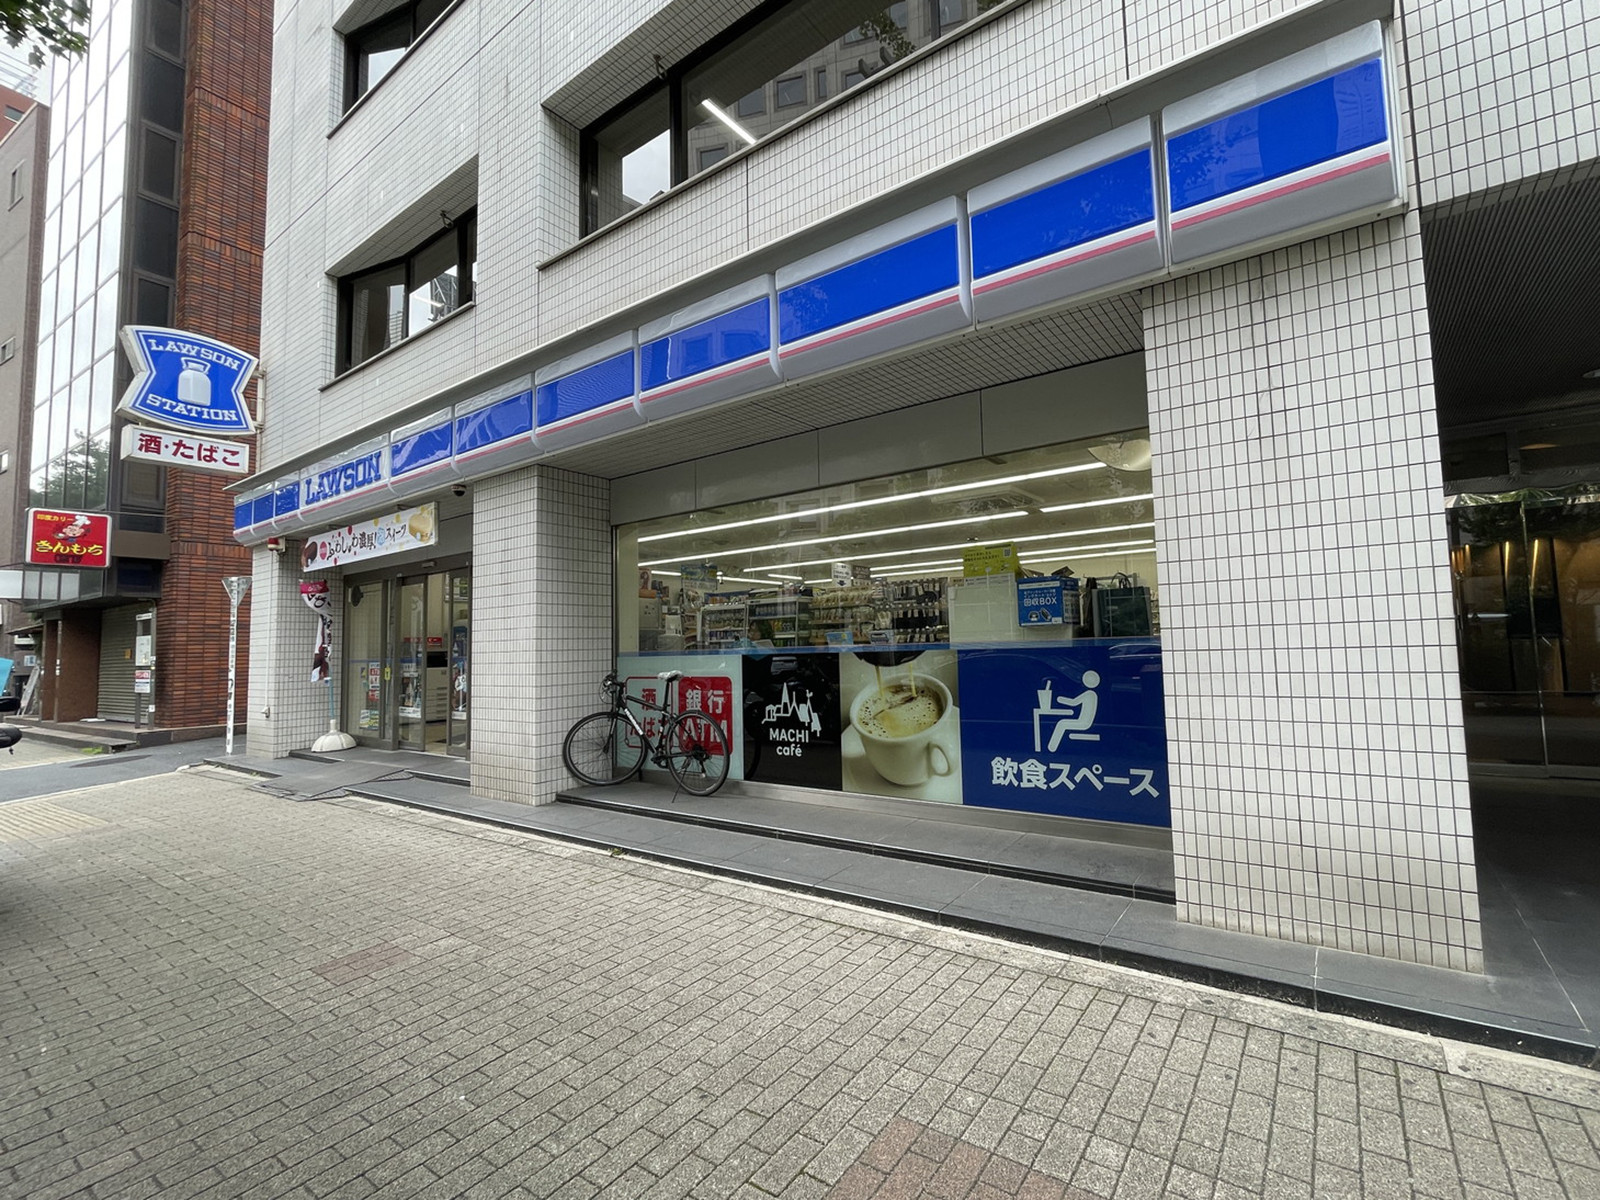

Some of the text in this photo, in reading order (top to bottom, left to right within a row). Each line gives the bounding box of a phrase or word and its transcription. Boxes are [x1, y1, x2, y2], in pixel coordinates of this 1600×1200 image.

[147, 338, 241, 371] LAWSON
[146, 393, 238, 421] STATION
[137, 433, 241, 467] 酒・たばこ
[303, 450, 382, 506] LAWSON
[36, 540, 103, 556] きんもち
[1023, 597, 1058, 607] 回収BOX
[685, 689, 725, 714] 銀行
[684, 718, 728, 743] ATM
[769, 728, 809, 743] MACHI
[776, 743, 802, 757] café
[991, 756, 1160, 799] 飲食スペース
